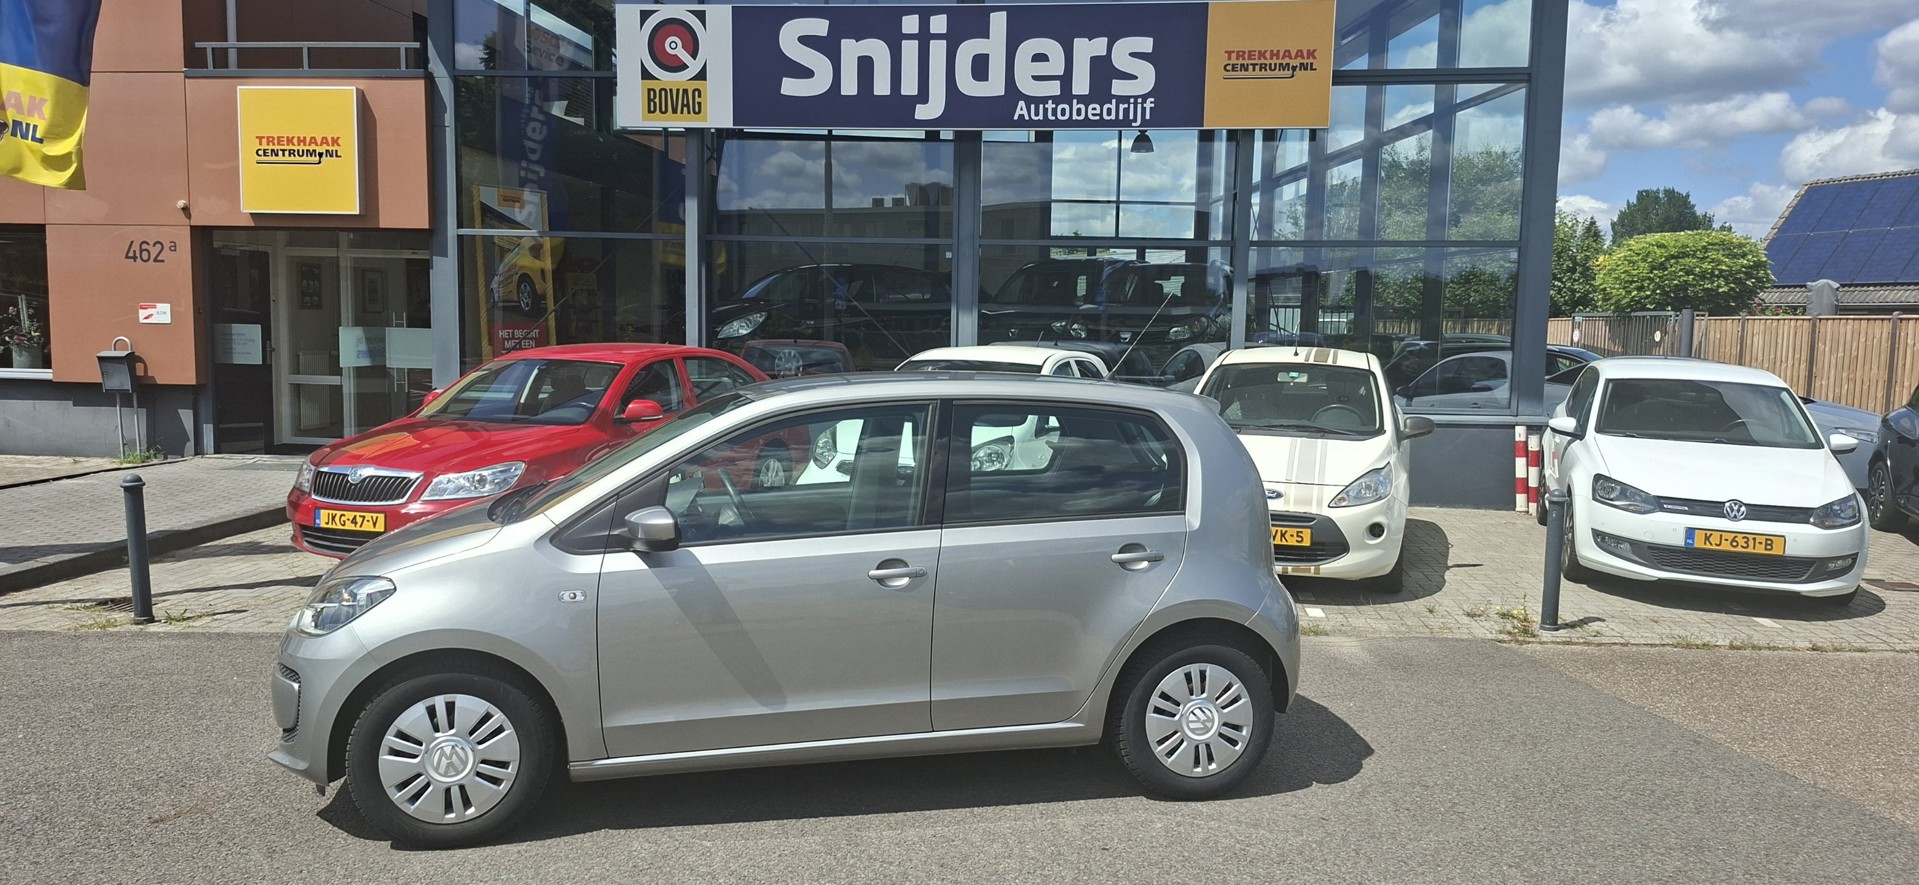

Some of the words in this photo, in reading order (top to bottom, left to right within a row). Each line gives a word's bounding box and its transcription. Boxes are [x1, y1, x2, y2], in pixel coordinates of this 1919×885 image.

[1224, 48, 1318, 61] TREKHAAK
[779, 11, 1156, 120] Snijders
[647, 87, 703, 116] BOVAG
[1013, 98, 1155, 127] Autobedrijf
[255, 135, 341, 147] TREKHAAK
[499, 329, 514, 339] HET
[521, 339, 536, 348] EEN
[324, 512, 379, 529] JKG-47-V
[1703, 532, 1774, 551] KJ-631-B
